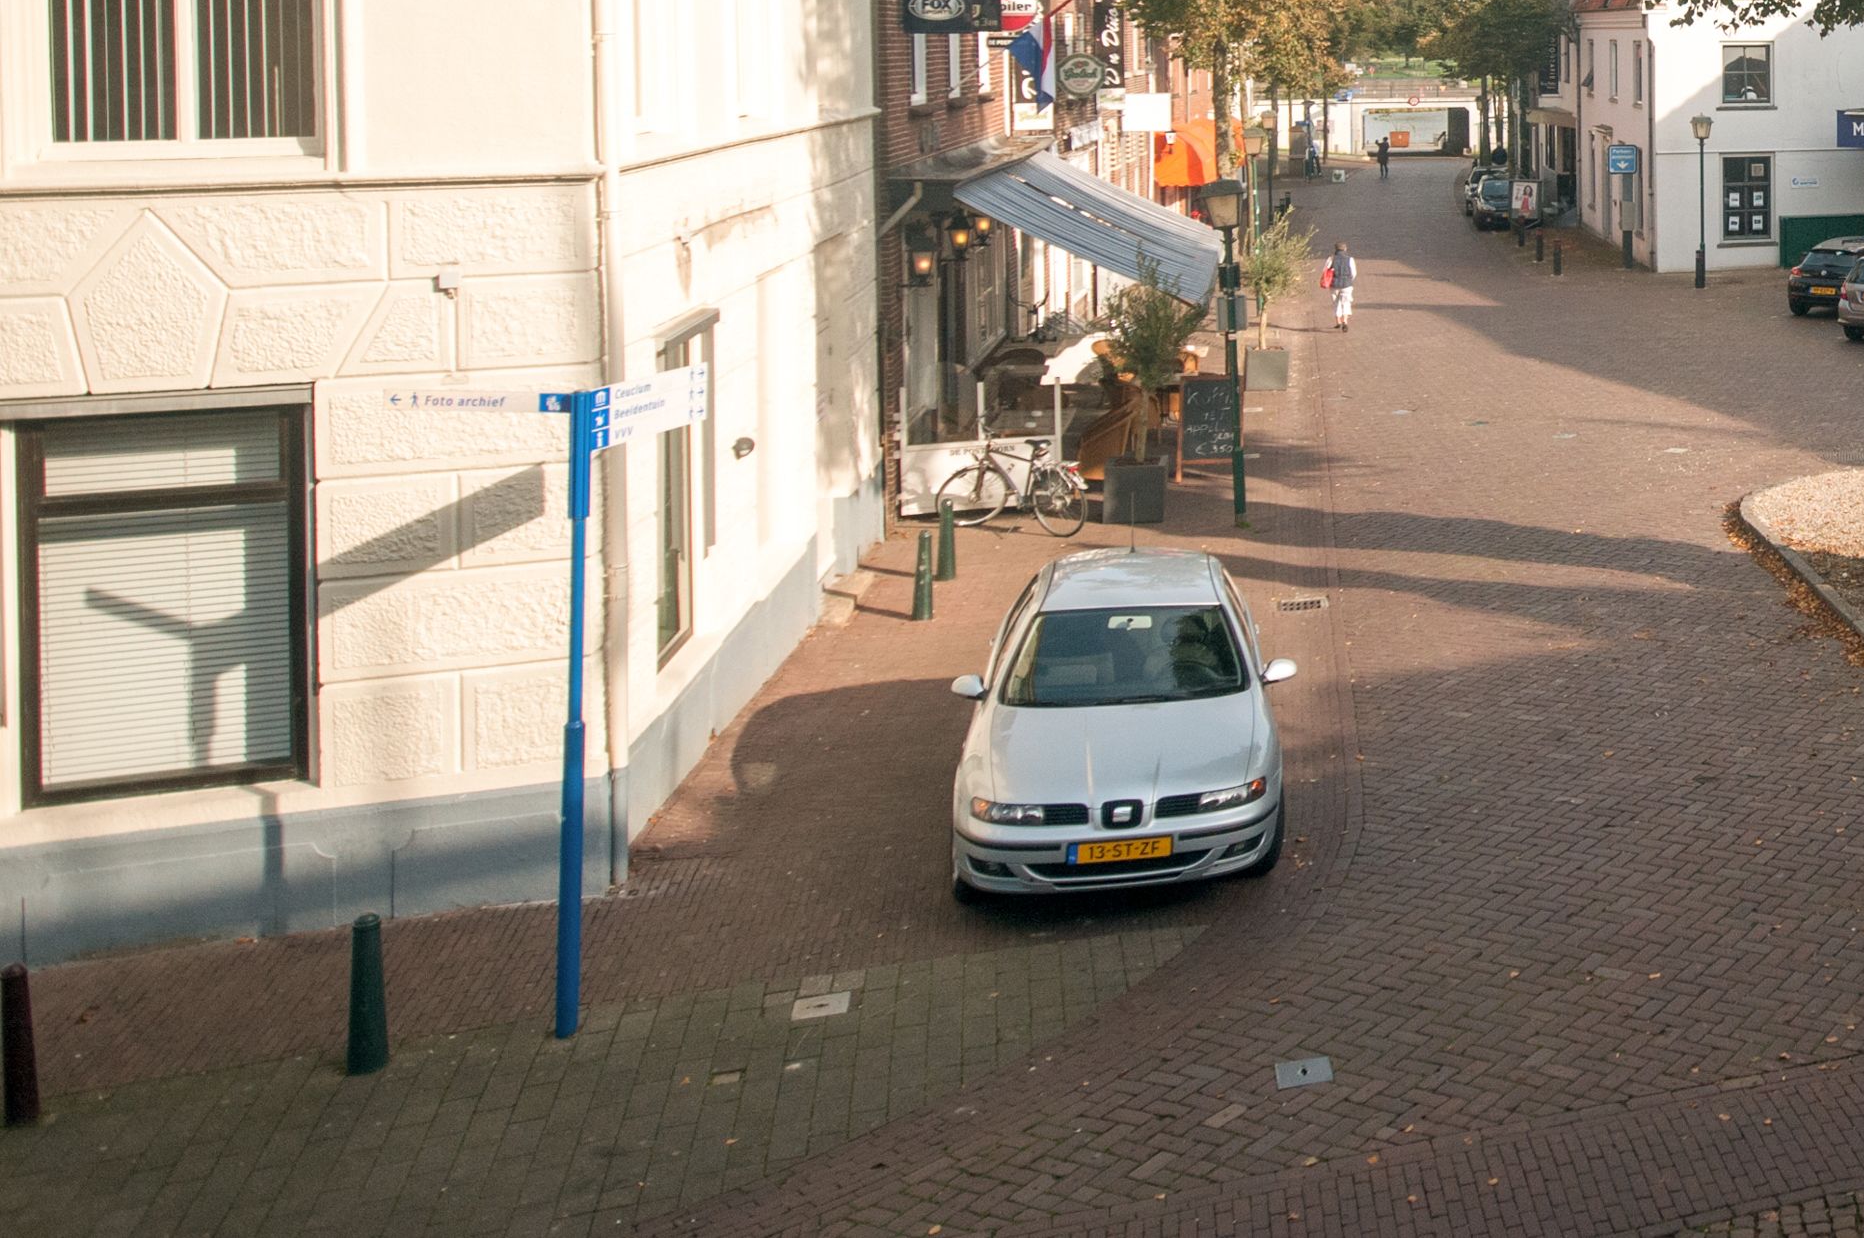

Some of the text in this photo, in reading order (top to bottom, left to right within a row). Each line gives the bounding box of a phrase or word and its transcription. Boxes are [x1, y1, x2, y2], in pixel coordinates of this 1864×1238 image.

[424, 395, 506, 408] Foto archief
[613, 398, 666, 420] Beeldentuin
[614, 426, 634, 440] VVV
[1089, 840, 1161, 860] 13-ST-ZF
